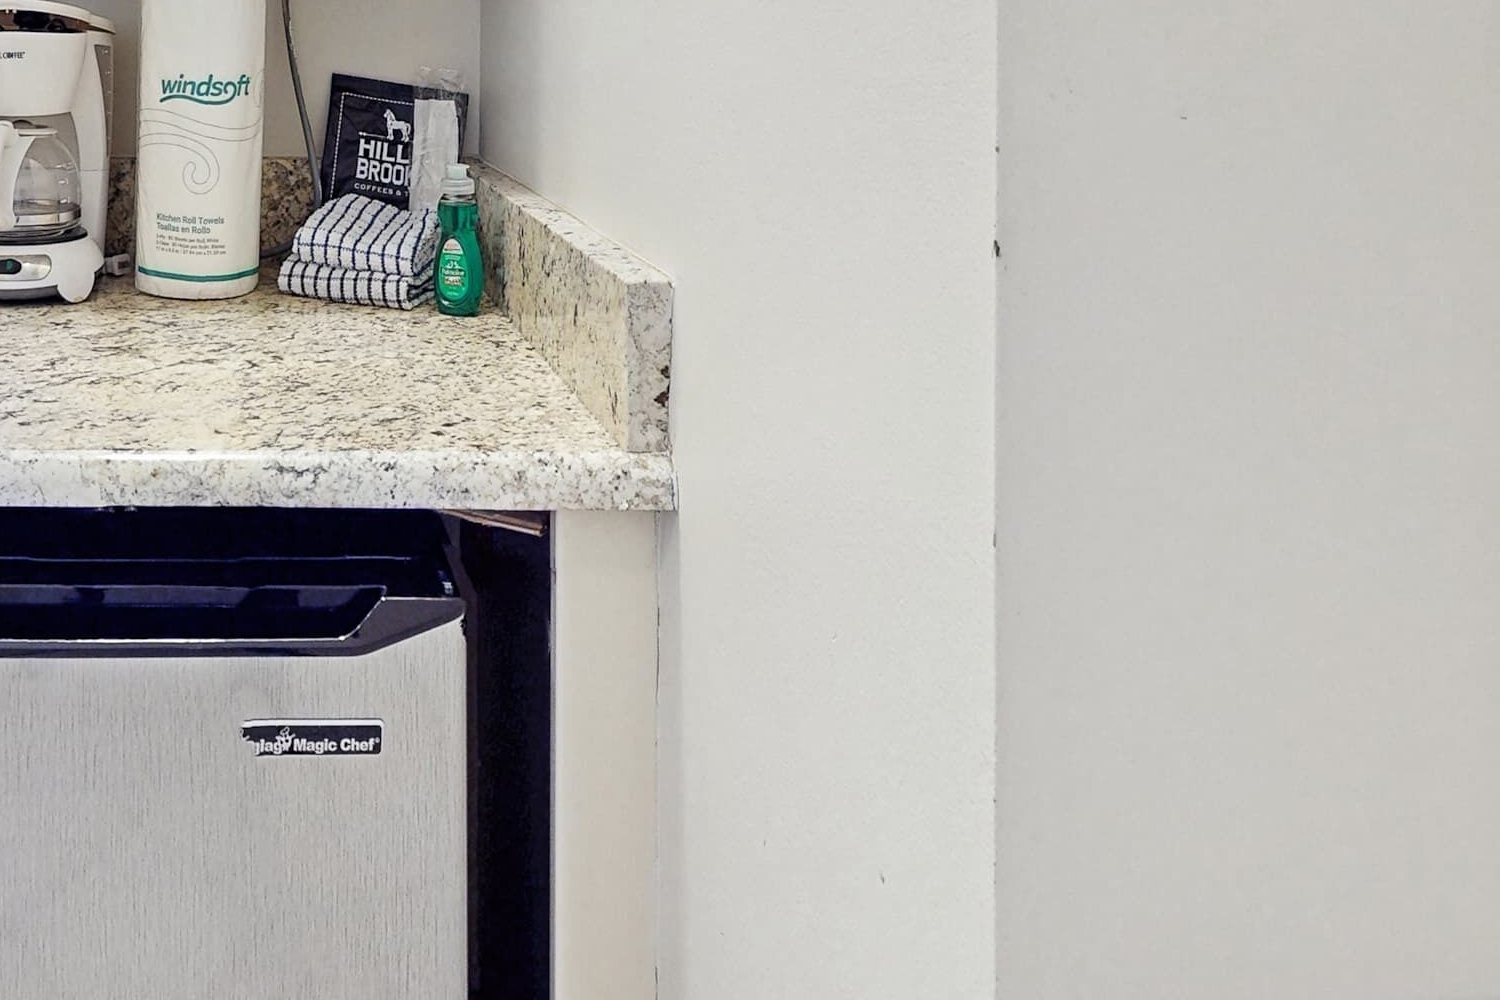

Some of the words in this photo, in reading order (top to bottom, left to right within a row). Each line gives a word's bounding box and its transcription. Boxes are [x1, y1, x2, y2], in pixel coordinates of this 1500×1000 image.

[161, 74, 250, 99] windsoft
[358, 138, 410, 164] HILL
[354, 182, 393, 195] COFFEES
[156, 213, 181, 223] Kitchen
[182, 216, 197, 224] Roll
[198, 217, 225, 225] Towels
[191, 226, 211, 234] Rollo
[293, 738, 337, 755] Magic
[339, 737, 375, 751] Chef
